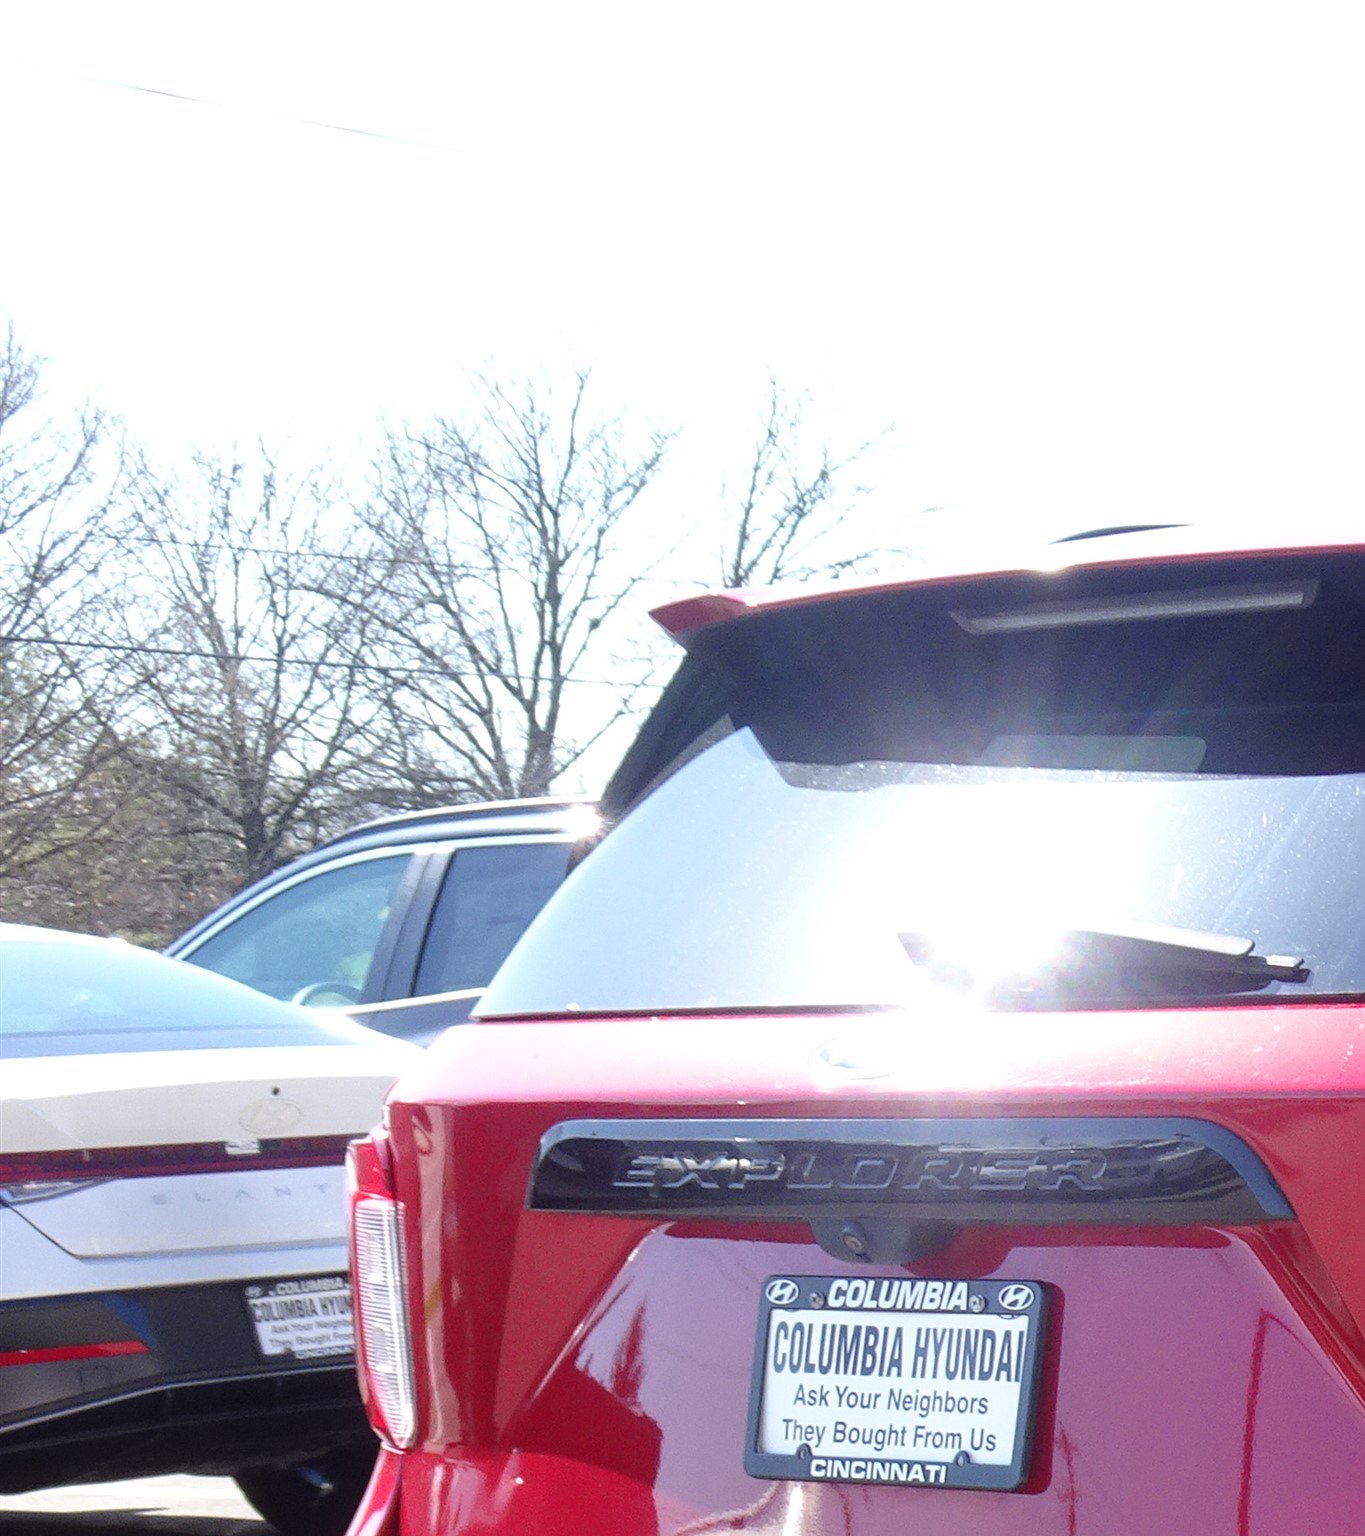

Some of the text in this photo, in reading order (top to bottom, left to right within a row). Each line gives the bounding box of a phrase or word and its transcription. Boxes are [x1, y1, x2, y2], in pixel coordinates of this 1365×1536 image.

[612, 1149, 1108, 1191] EXPLORER
[251, 1298, 318, 1322] COLUMBIA
[828, 1279, 969, 1311] COLUMBIA
[773, 1320, 1026, 1383] COLUMBIA HYUNDAI
[793, 1384, 989, 1418] Ask Your Neighbors
[782, 1418, 997, 1452] They Bought From Us
[810, 1459, 948, 1483] CINCINNATI
